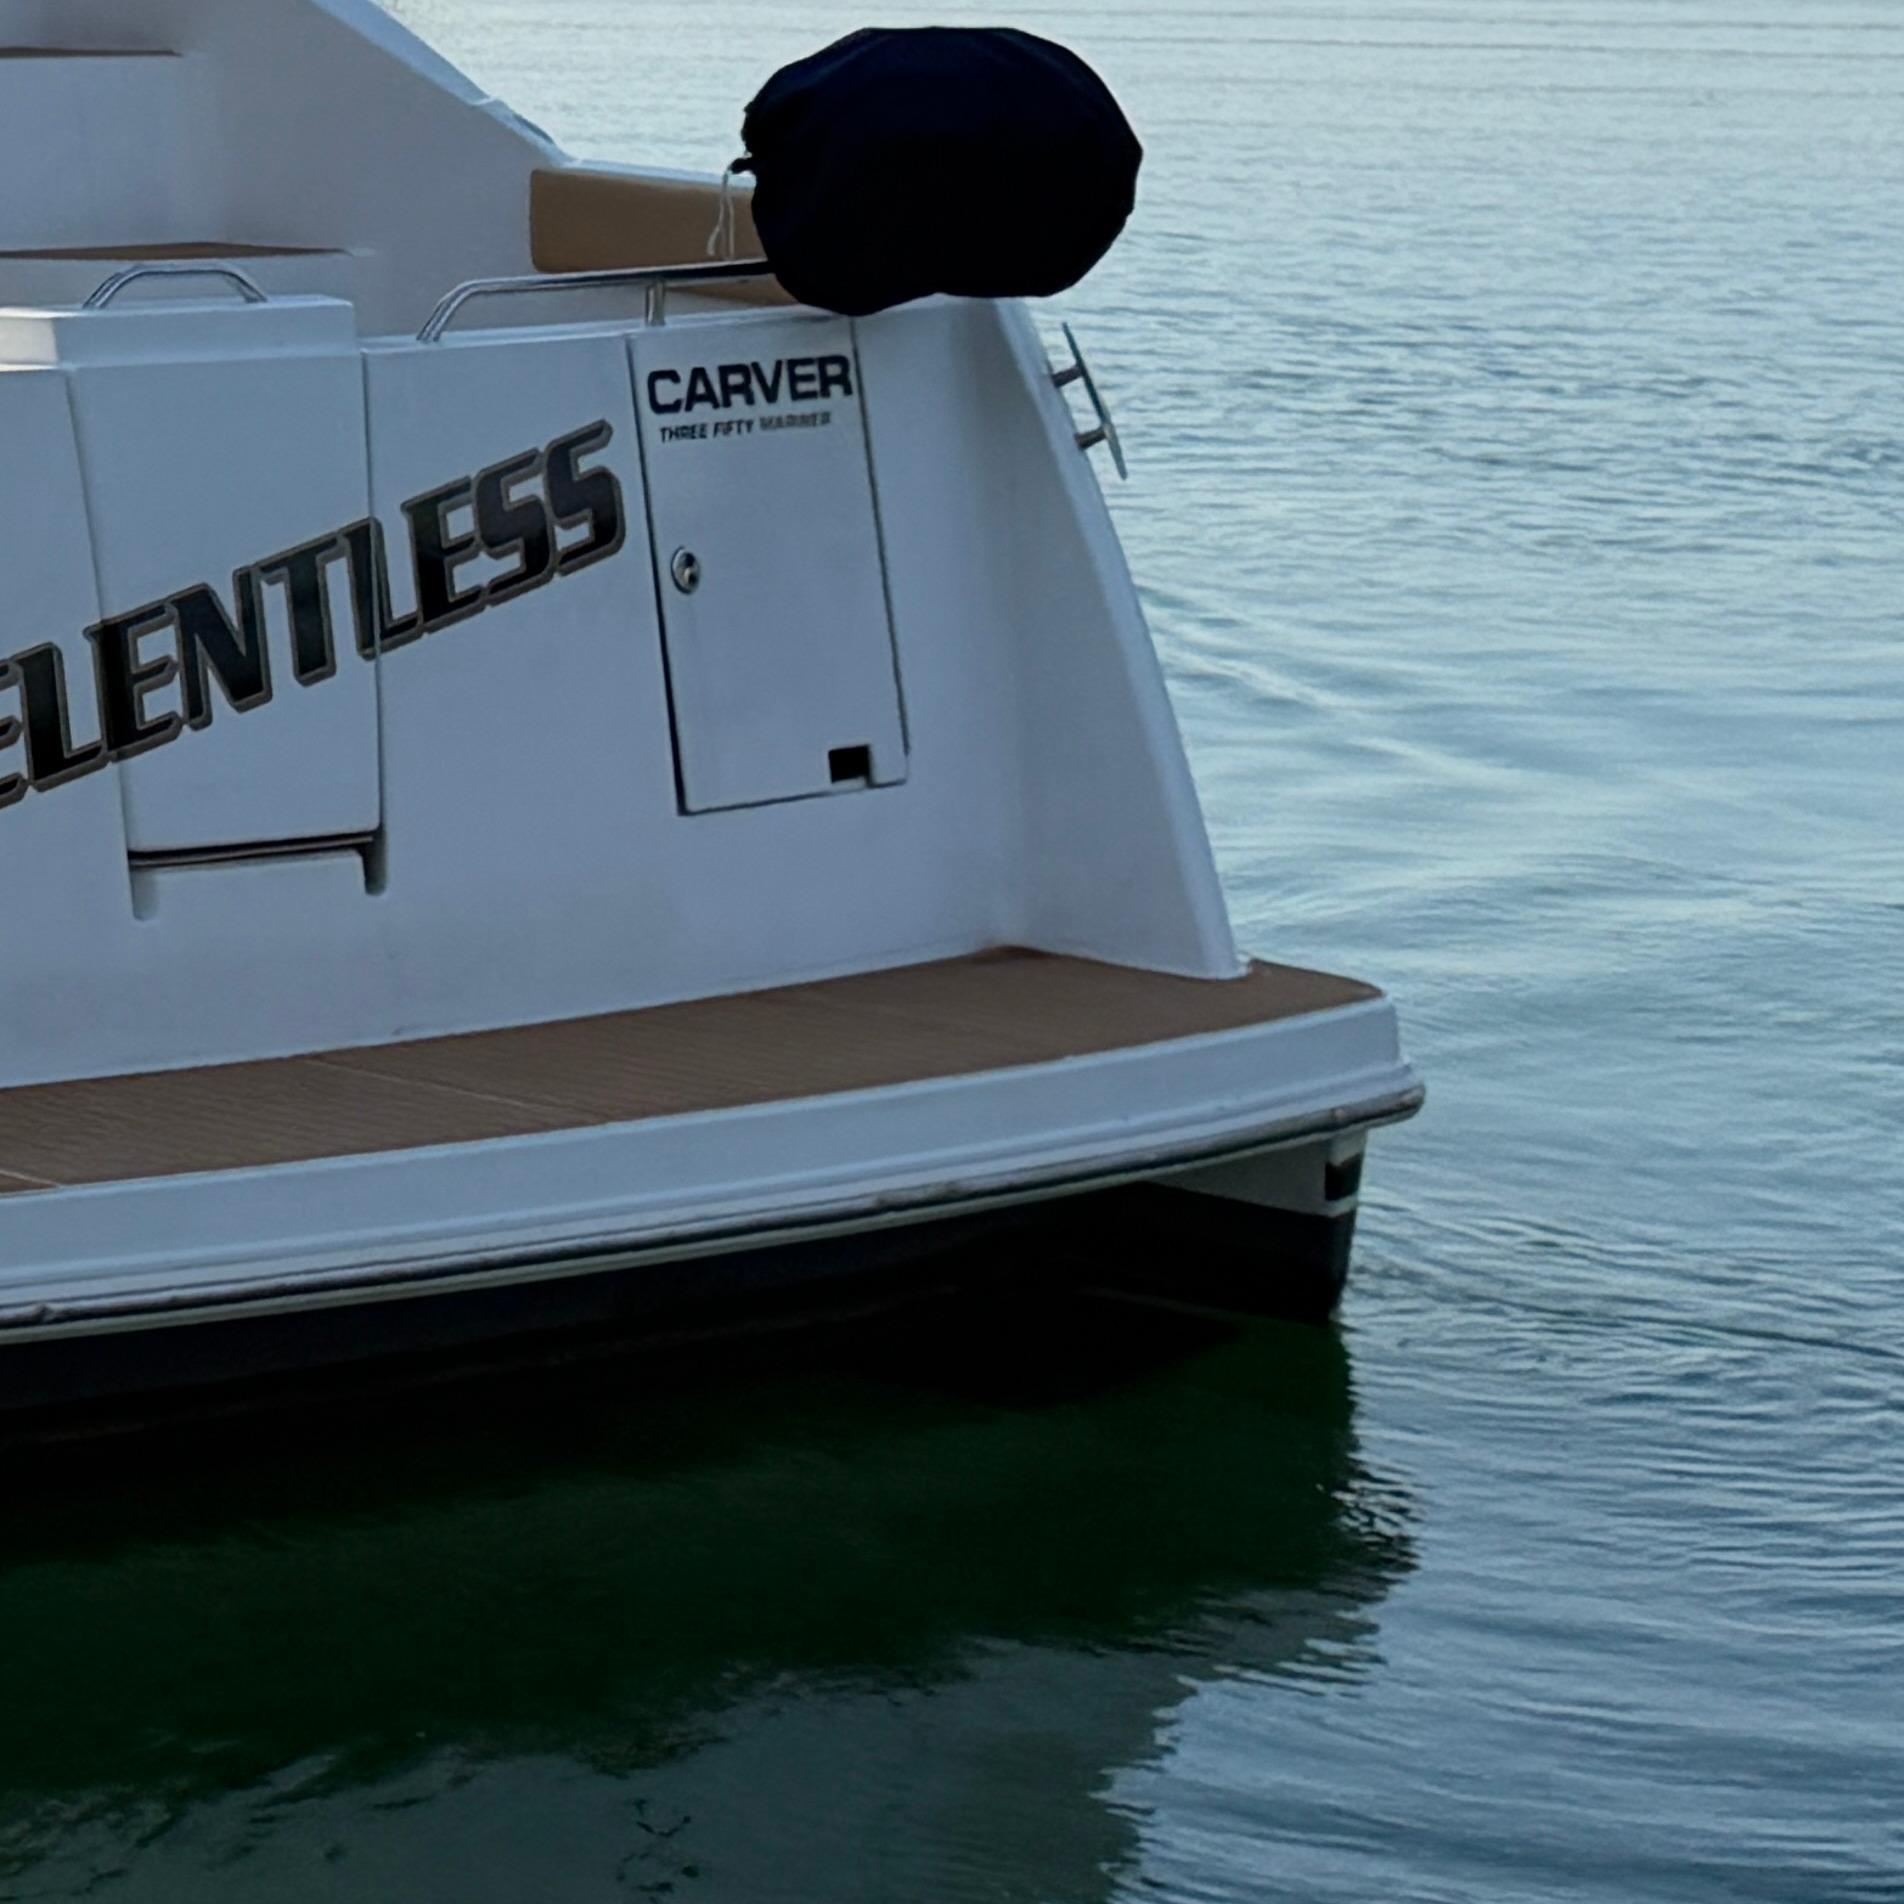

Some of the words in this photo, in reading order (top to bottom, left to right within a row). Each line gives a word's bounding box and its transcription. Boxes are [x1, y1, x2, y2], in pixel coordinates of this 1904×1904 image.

[647, 354, 853, 414] CARVER
[660, 421, 708, 443] THREE
[713, 418, 754, 438] FIFTY
